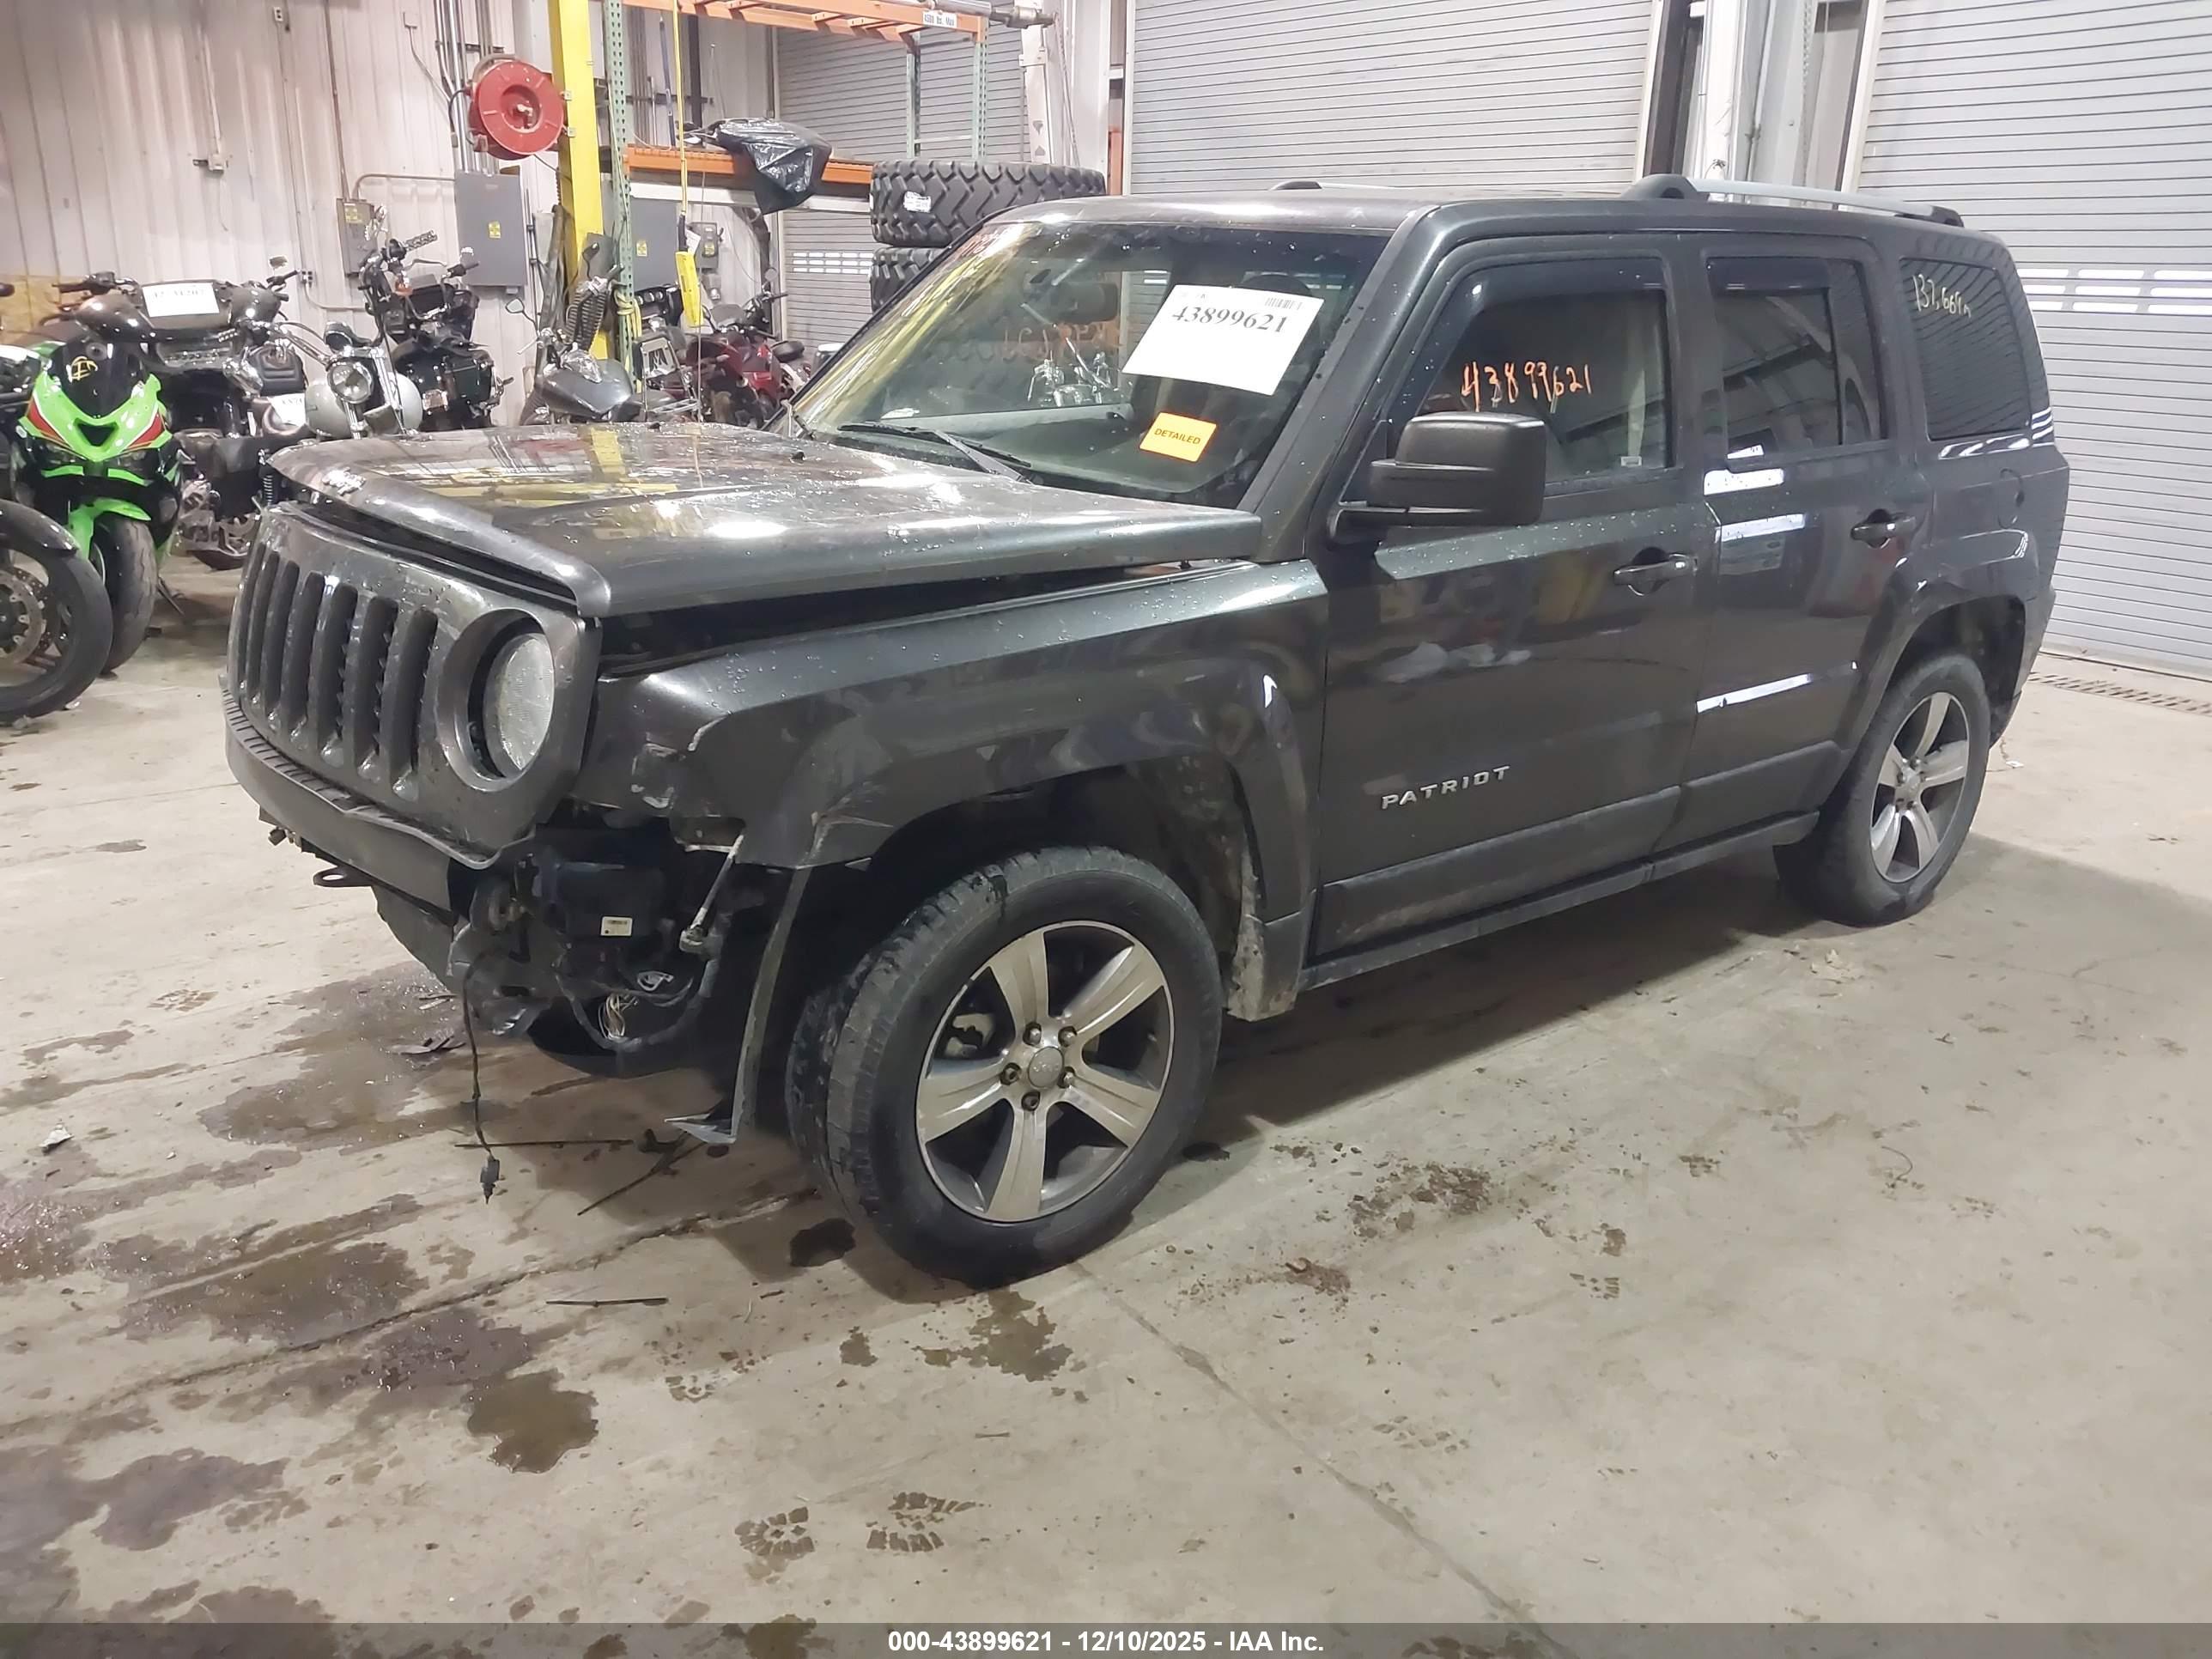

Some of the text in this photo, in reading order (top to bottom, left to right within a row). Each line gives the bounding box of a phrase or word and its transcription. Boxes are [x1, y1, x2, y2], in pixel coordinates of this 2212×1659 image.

[1172, 306, 1287, 332] 43899621
[1462, 361, 1591, 413] 43899621
[1153, 428, 1201, 446] DETAILED
[1381, 765, 1510, 810] PATRIOT
